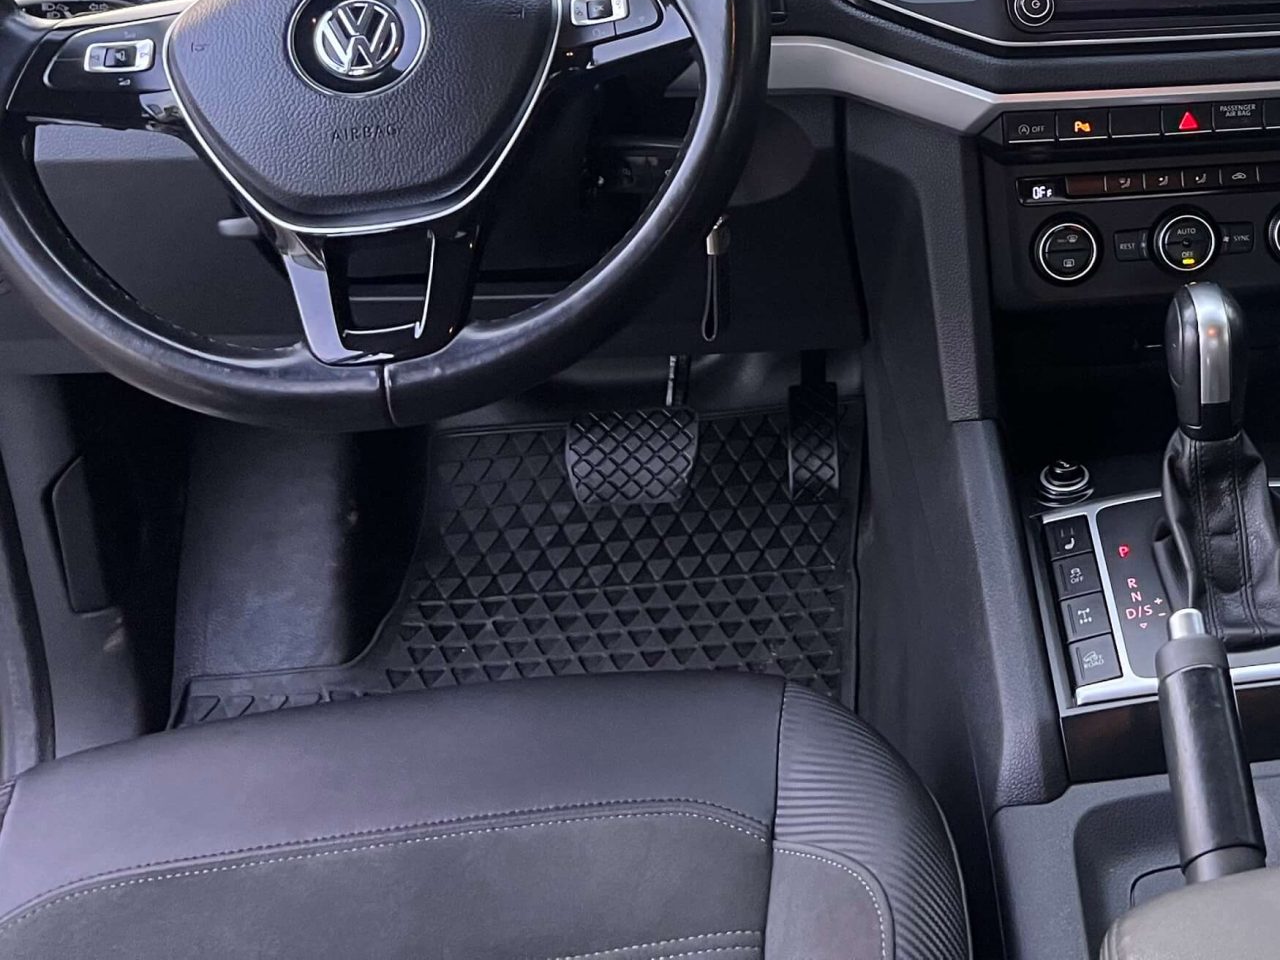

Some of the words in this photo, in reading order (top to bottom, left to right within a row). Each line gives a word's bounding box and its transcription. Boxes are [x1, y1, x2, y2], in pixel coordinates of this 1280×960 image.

[332, 124, 399, 142] AIRBAG
[1031, 125, 1045, 133] OFF
[1177, 227, 1197, 235] AUTO
[1233, 234, 1250, 242] SYNC
[1119, 242, 1136, 250] REST
[1119, 545, 1130, 558] P
[1070, 575, 1084, 584] OFF
[1127, 578, 1137, 589] R
[1131, 591, 1142, 602] N
